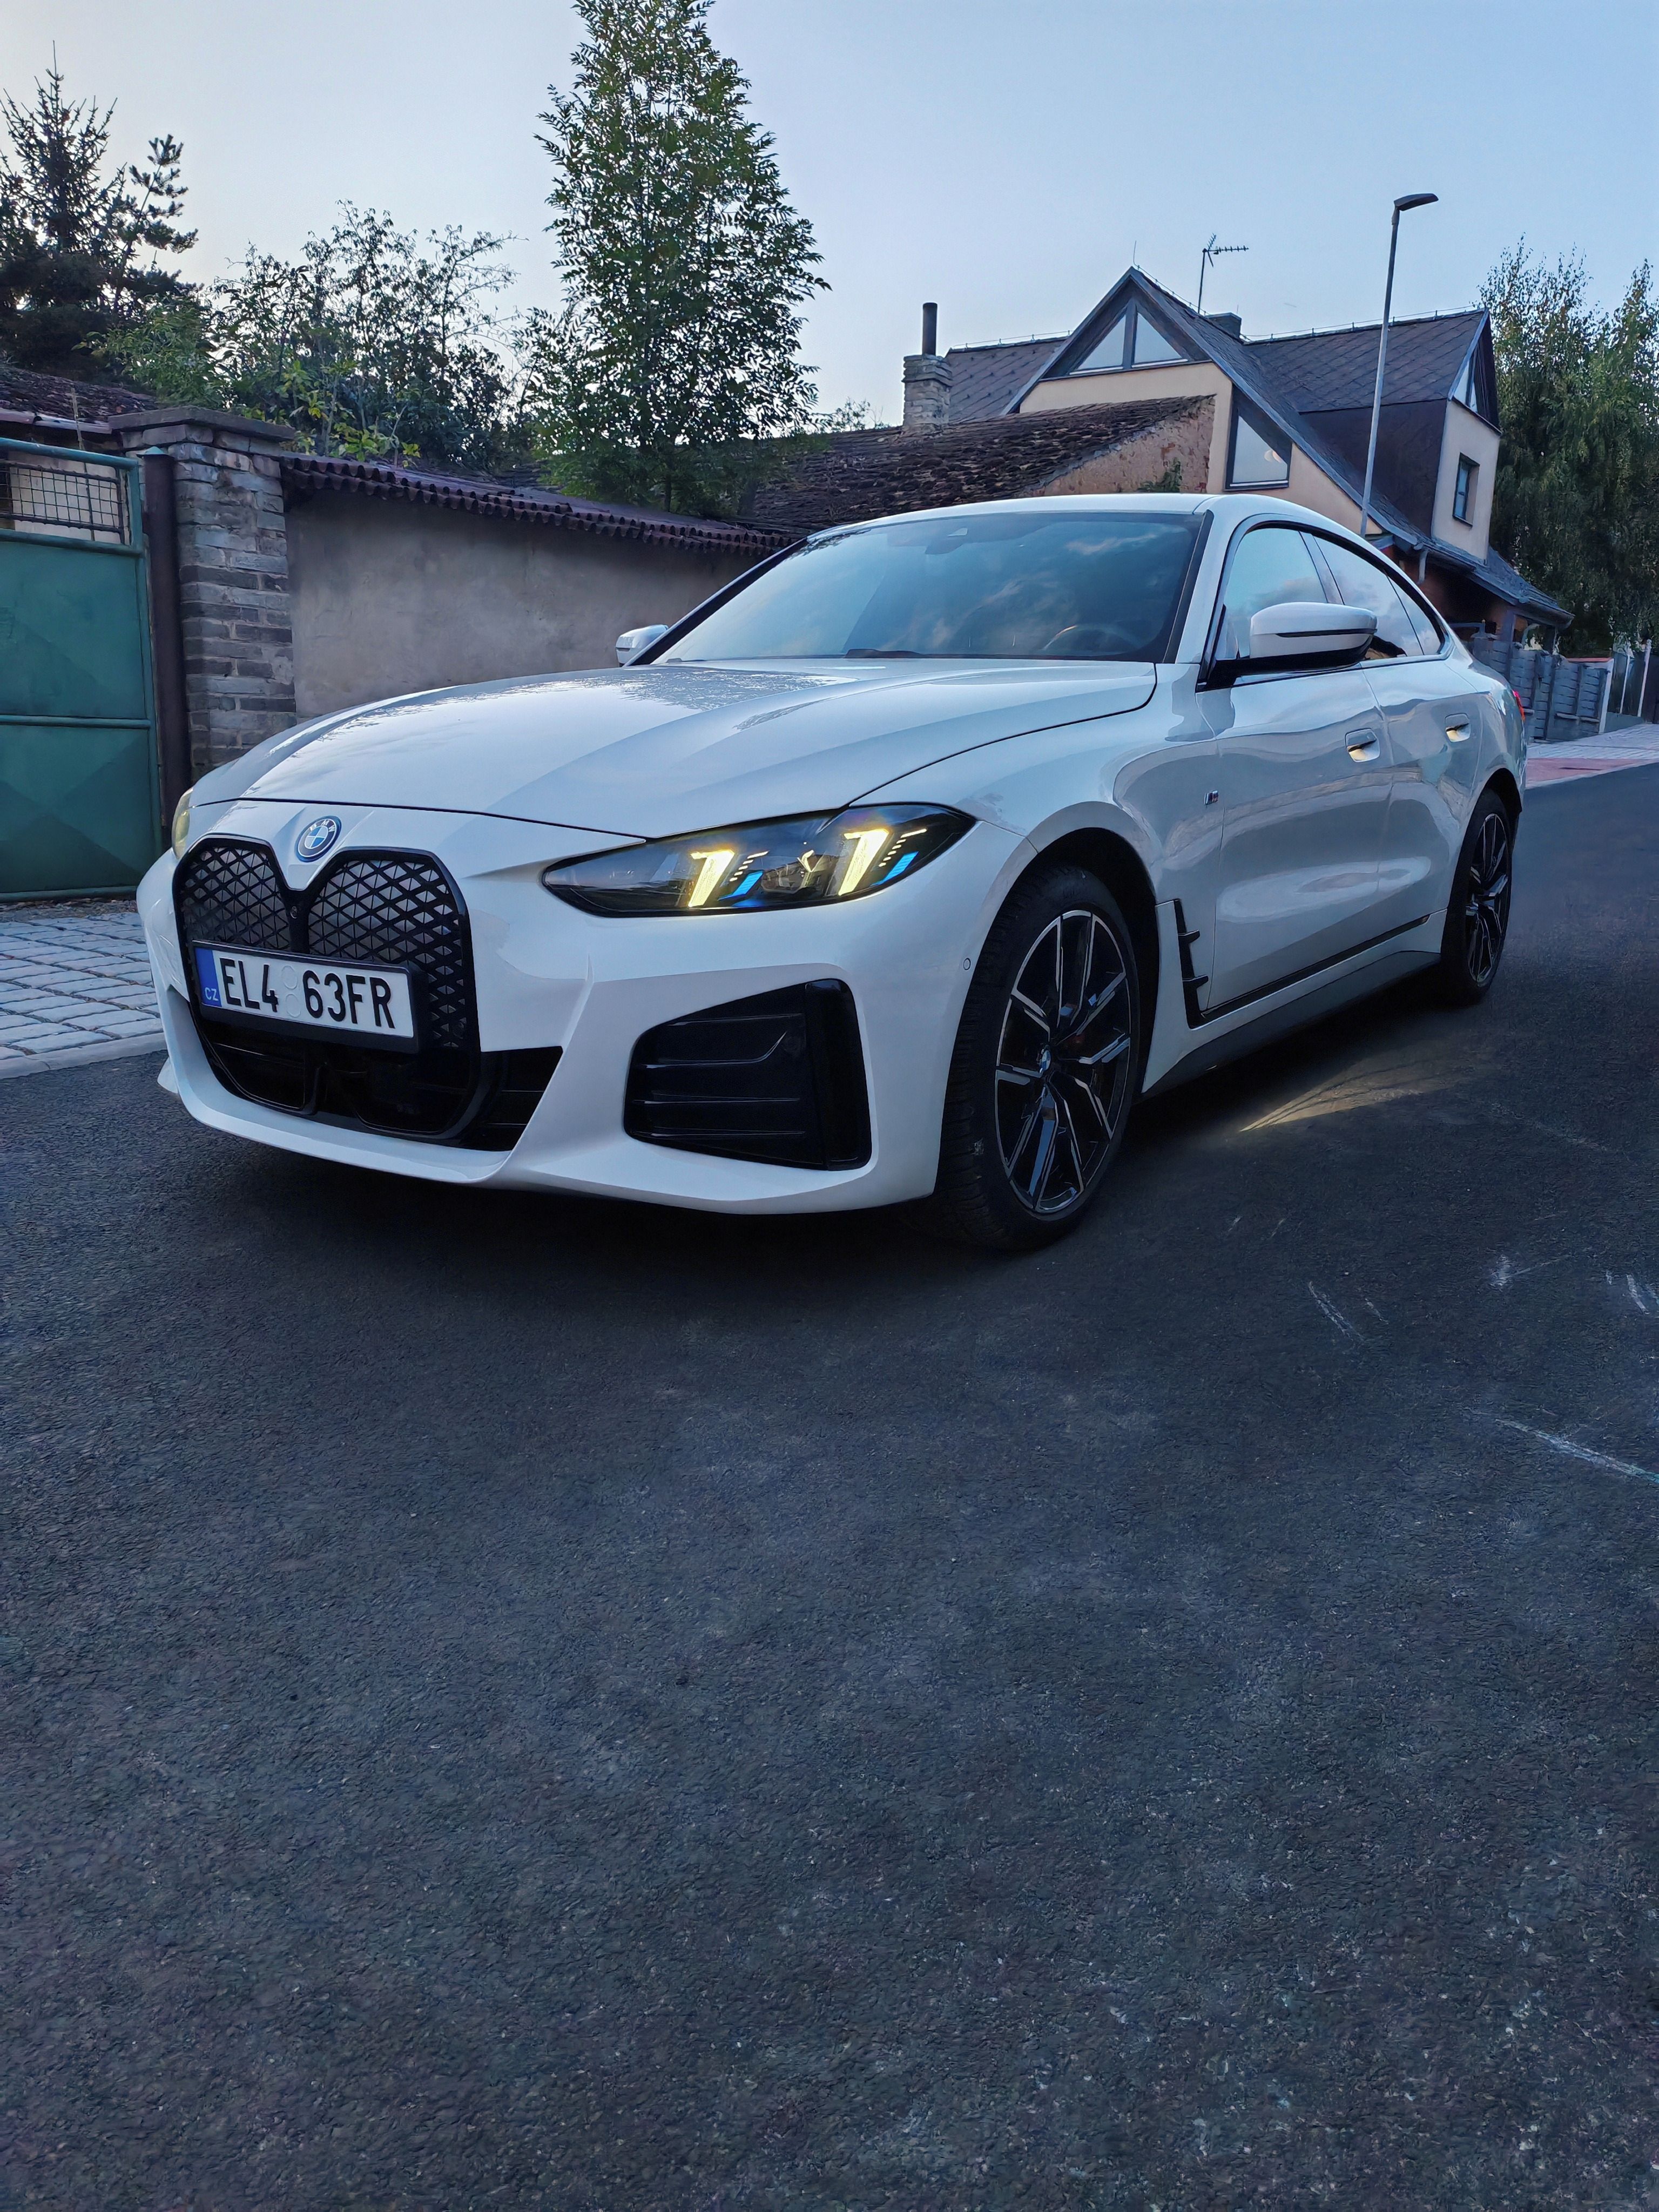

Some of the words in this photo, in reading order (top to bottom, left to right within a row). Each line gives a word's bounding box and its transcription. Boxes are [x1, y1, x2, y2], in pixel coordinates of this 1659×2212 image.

[205, 987, 219, 1001] CZ
[219, 957, 278, 1013] EL4
[302, 970, 395, 1029] 63FR
